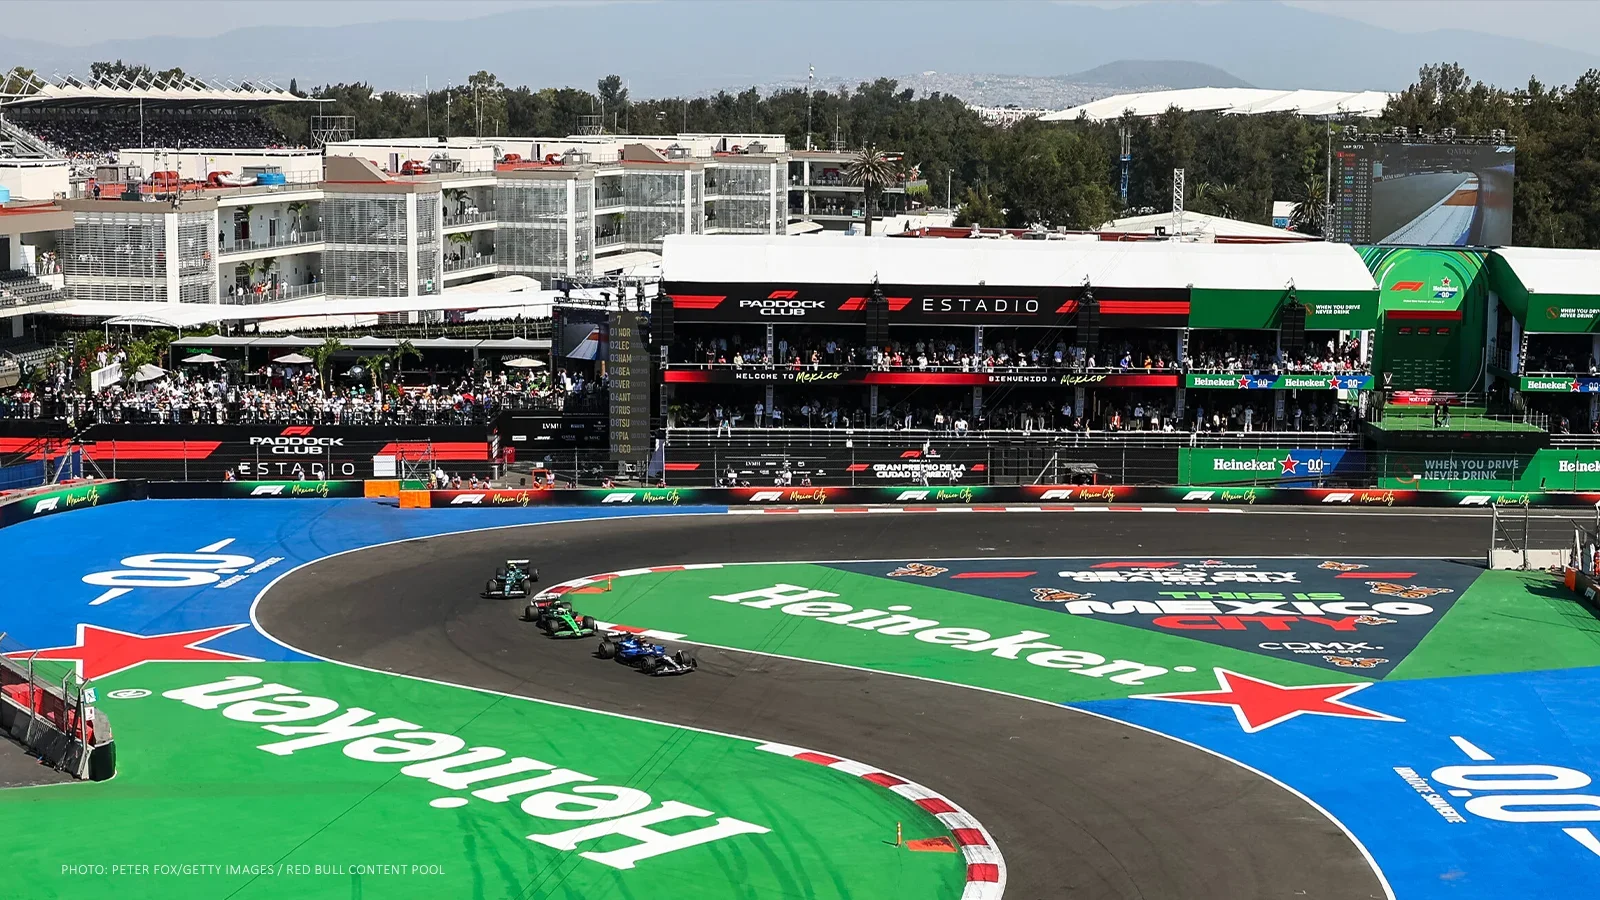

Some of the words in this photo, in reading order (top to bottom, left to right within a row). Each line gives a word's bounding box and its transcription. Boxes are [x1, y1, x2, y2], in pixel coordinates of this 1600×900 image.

[740, 300, 825, 308] PADDOCK
[923, 299, 1038, 312] ESTADIO
[760, 308, 805, 316] CLUB
[796, 371, 842, 383] Mexico
[989, 375, 1047, 383] BIENVENIDO
[1060, 374, 1106, 385] Mexico
[1194, 378, 1235, 386] Heineken
[1285, 378, 1325, 386] Heineken
[1528, 381, 1567, 389] Heineken
[250, 437, 344, 446] PADDOCK
[272, 446, 322, 454] CLUB
[240, 462, 354, 475] ESTADIO
[1214, 458, 1276, 470] Heineken
[1425, 460, 1457, 469] WHEN
[1461, 460, 1483, 469] YOU
[1488, 460, 1518, 469] DRIVE
[1424, 471, 1459, 480] NEVER
[1463, 471, 1496, 480] DRINK
[250, 485, 286, 495] F1
[292, 484, 314, 494] Mexico
[317, 481, 329, 497] City
[896, 490, 930, 500] F1
[936, 490, 957, 500] Mexico
[960, 487, 972, 503] City
[1040, 490, 1073, 499] F1
[1080, 490, 1101, 499] Mexico
[1102, 486, 1115, 502] City
[33, 496, 60, 514] F1
[66, 493, 86, 506] Mexico
[87, 486, 100, 506] City
[450, 493, 485, 504] F1
[493, 493, 514, 504] Mexico
[517, 491, 530, 506] City
[601, 492, 636, 503] F1
[643, 492, 665, 502] Mexico
[667, 488, 680, 505] City
[749, 491, 784, 501] F1
[790, 491, 812, 500] Mexico
[814, 488, 827, 504] City
[1182, 491, 1216, 500] F1
[1221, 491, 1242, 501] Mexico
[1243, 488, 1256, 504] City
[1322, 493, 1354, 502] F1
[1360, 493, 1382, 503] Mexico
[1382, 490, 1395, 506] City
[1459, 496, 1491, 505] F1
[1496, 496, 1517, 505] Mexico
[1158, 592, 1286, 600] THIS
[1298, 592, 1345, 600] IS
[1064, 600, 1434, 615] MEXICO
[1152, 616, 1358, 631] CITY
[708, 583, 1169, 685] Heineken
[162, 675, 772, 870] Heineken
